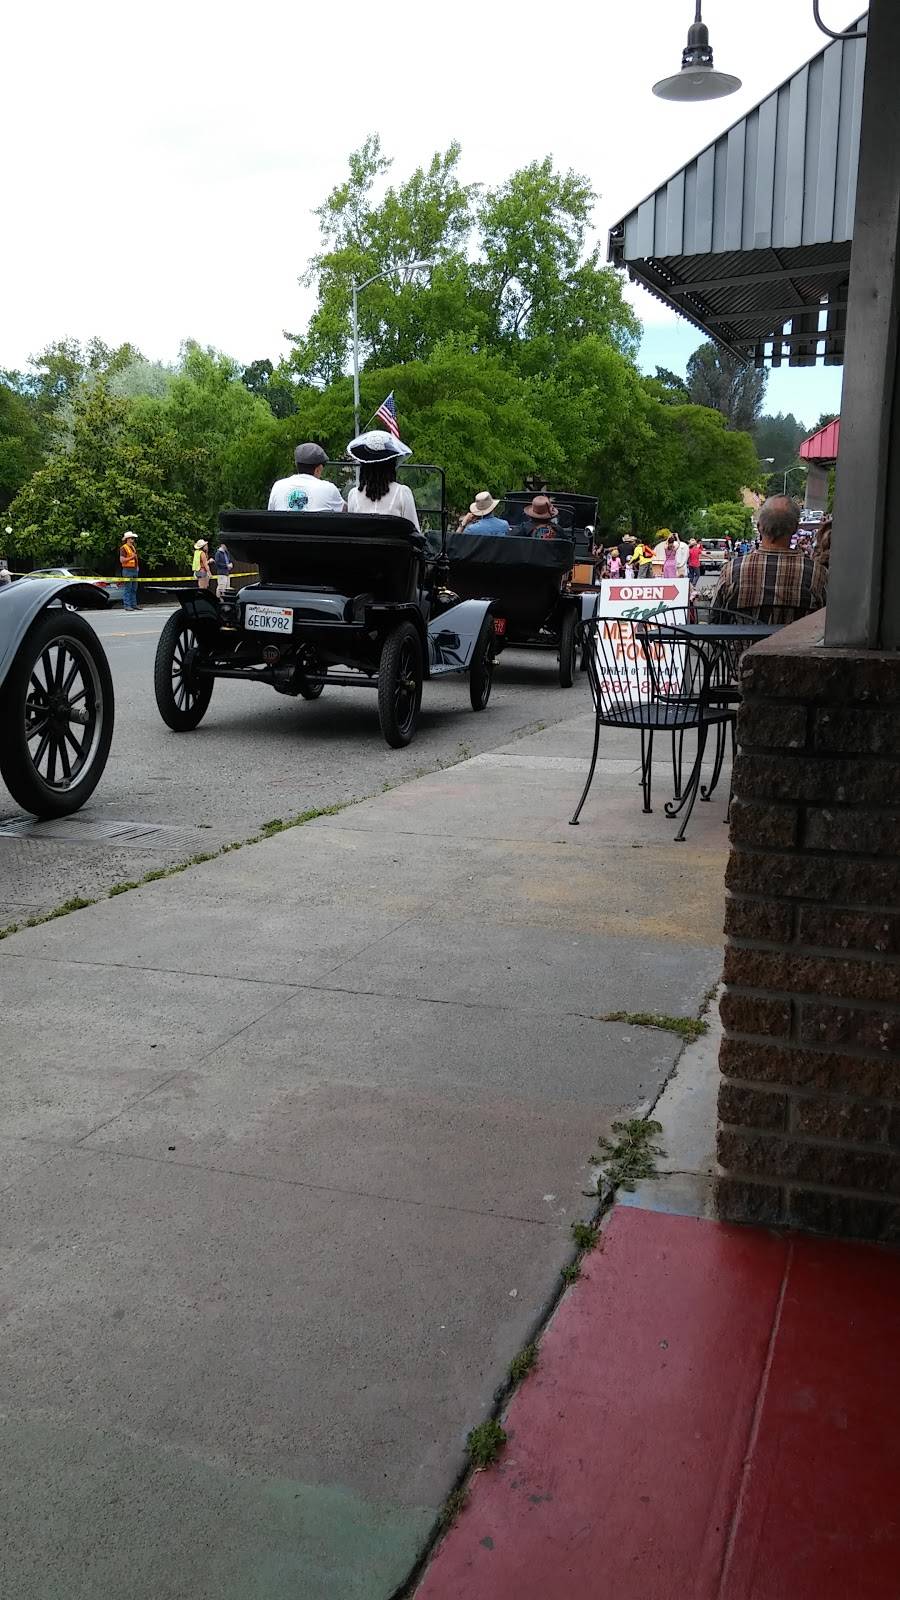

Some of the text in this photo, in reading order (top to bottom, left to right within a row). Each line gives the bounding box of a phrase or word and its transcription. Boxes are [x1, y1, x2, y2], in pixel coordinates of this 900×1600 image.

[619, 587, 665, 600] OPEN
[616, 643, 665, 660] FOOD
[600, 680, 679, 695] 887-841
